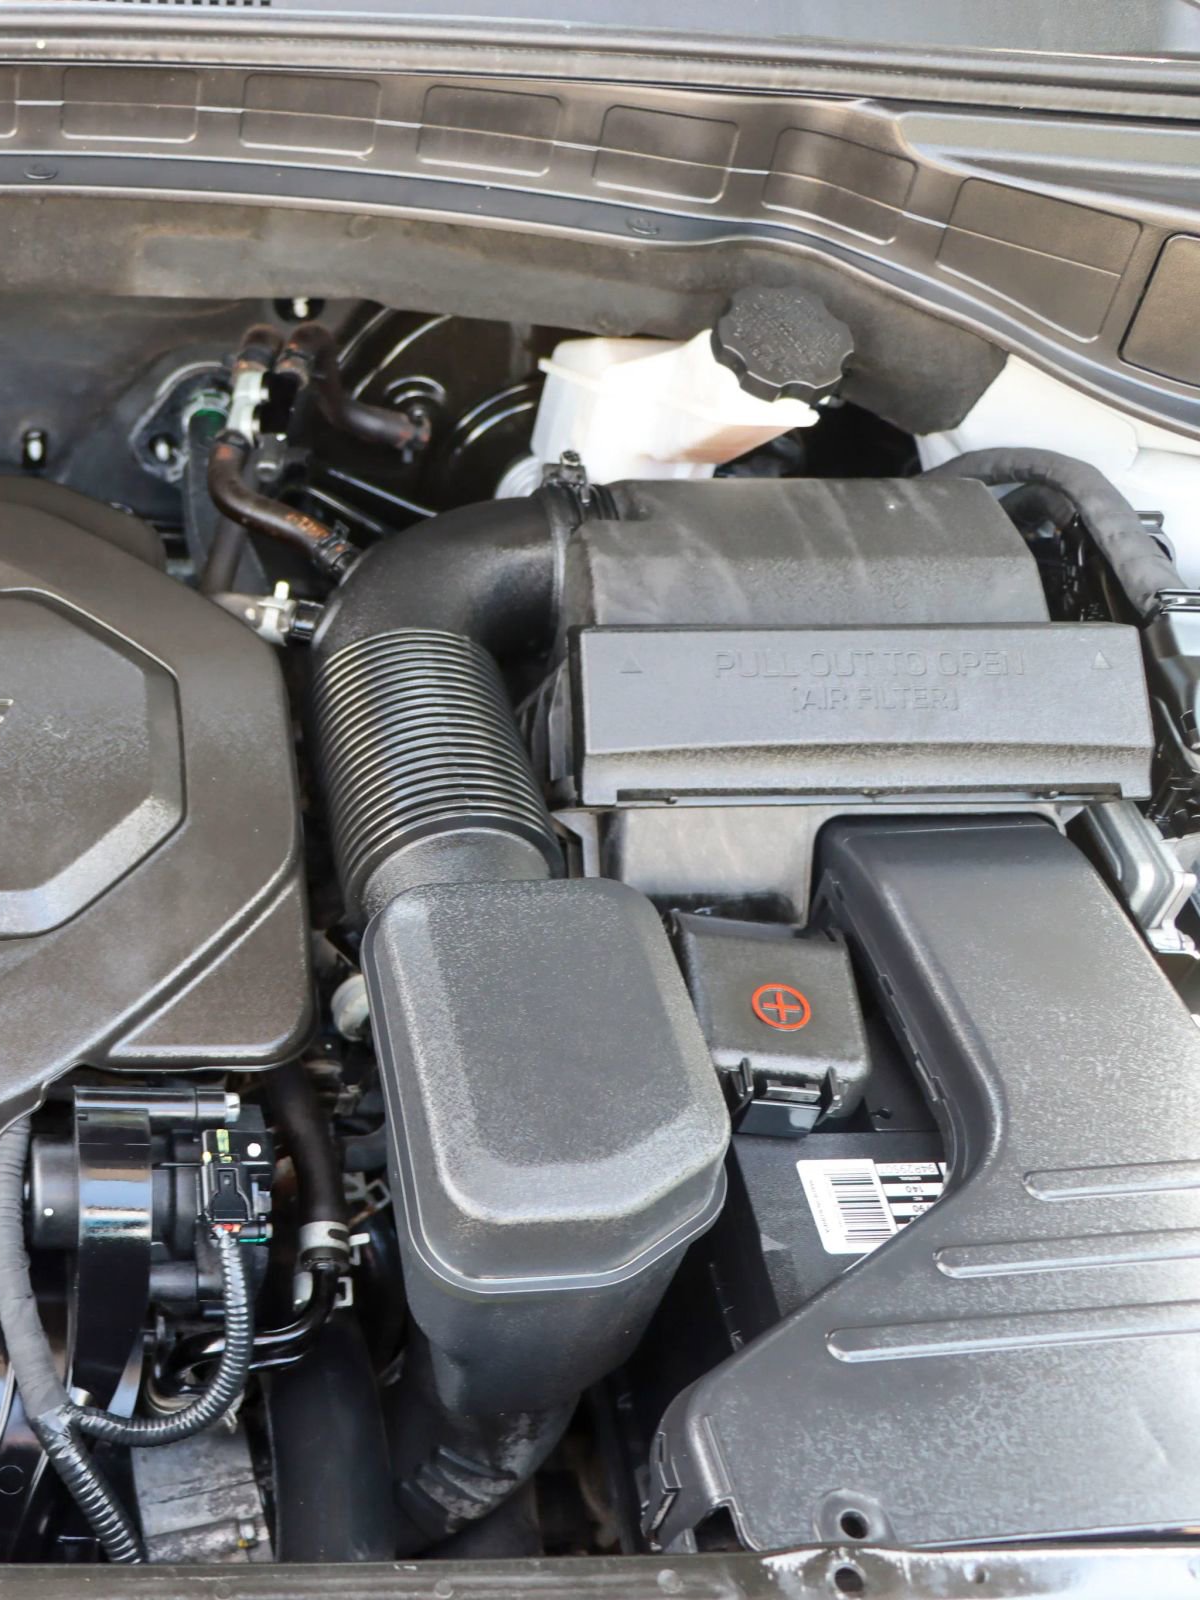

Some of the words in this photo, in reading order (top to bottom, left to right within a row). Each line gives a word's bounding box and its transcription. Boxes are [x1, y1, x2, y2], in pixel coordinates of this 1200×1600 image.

[714, 648, 800, 679] PULL
[809, 648, 874, 678] OUT
[880, 648, 929, 678] TO
[937, 647, 1025, 677] OPEN
